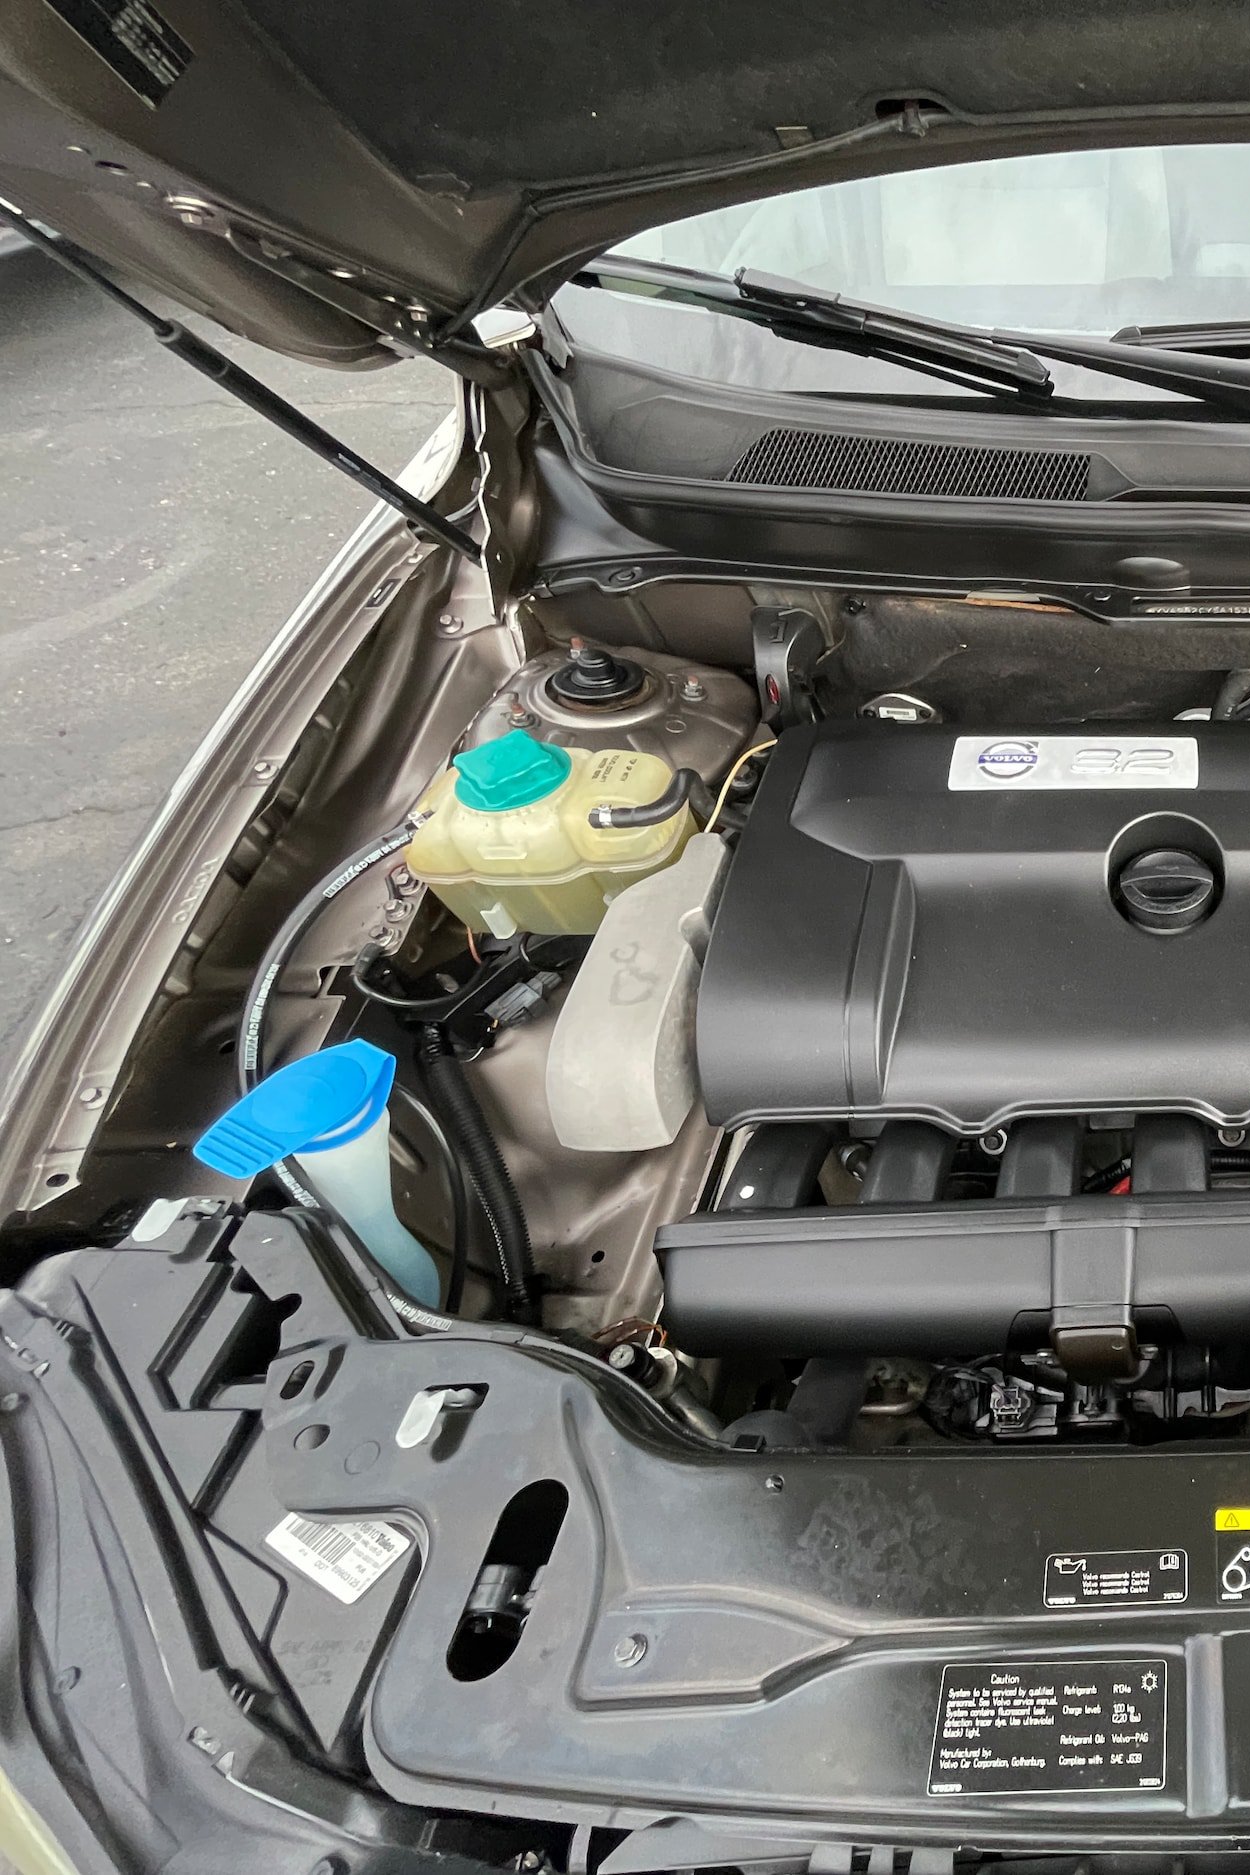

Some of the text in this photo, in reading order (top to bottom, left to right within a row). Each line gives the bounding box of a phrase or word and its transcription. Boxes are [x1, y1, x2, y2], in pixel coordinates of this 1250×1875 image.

[376, 1532, 395, 1552] Valeo
[1082, 1580, 1098, 1588] Volvo
[991, 1674, 1020, 1684] Caution
[948, 1687, 1054, 1699] System to be serviced by qualified
[1112, 1684, 1132, 1694] R134a
[979, 1698, 990, 1707] See
[993, 1698, 1011, 1706] Volvo
[1013, 1697, 1034, 1705] service
[946, 1709, 968, 1719] System
[1062, 1705, 1082, 1716] Charge
[1127, 1704, 1135, 1713] kg
[1009, 1717, 1021, 1725] Use
[1060, 1734, 1092, 1746] Refrigerant
[1112, 1733, 1149, 1743] Volvo-PAG
[940, 1748, 981, 1759] Manufactured
[939, 1760, 958, 1769] Volvo
[960, 1760, 972, 1769] Car
[973, 1758, 1009, 1769] Corporation,
[1059, 1755, 1086, 1766] Complies
[1110, 1754, 1124, 1764] SAE
[1126, 1754, 1142, 1763] J639
